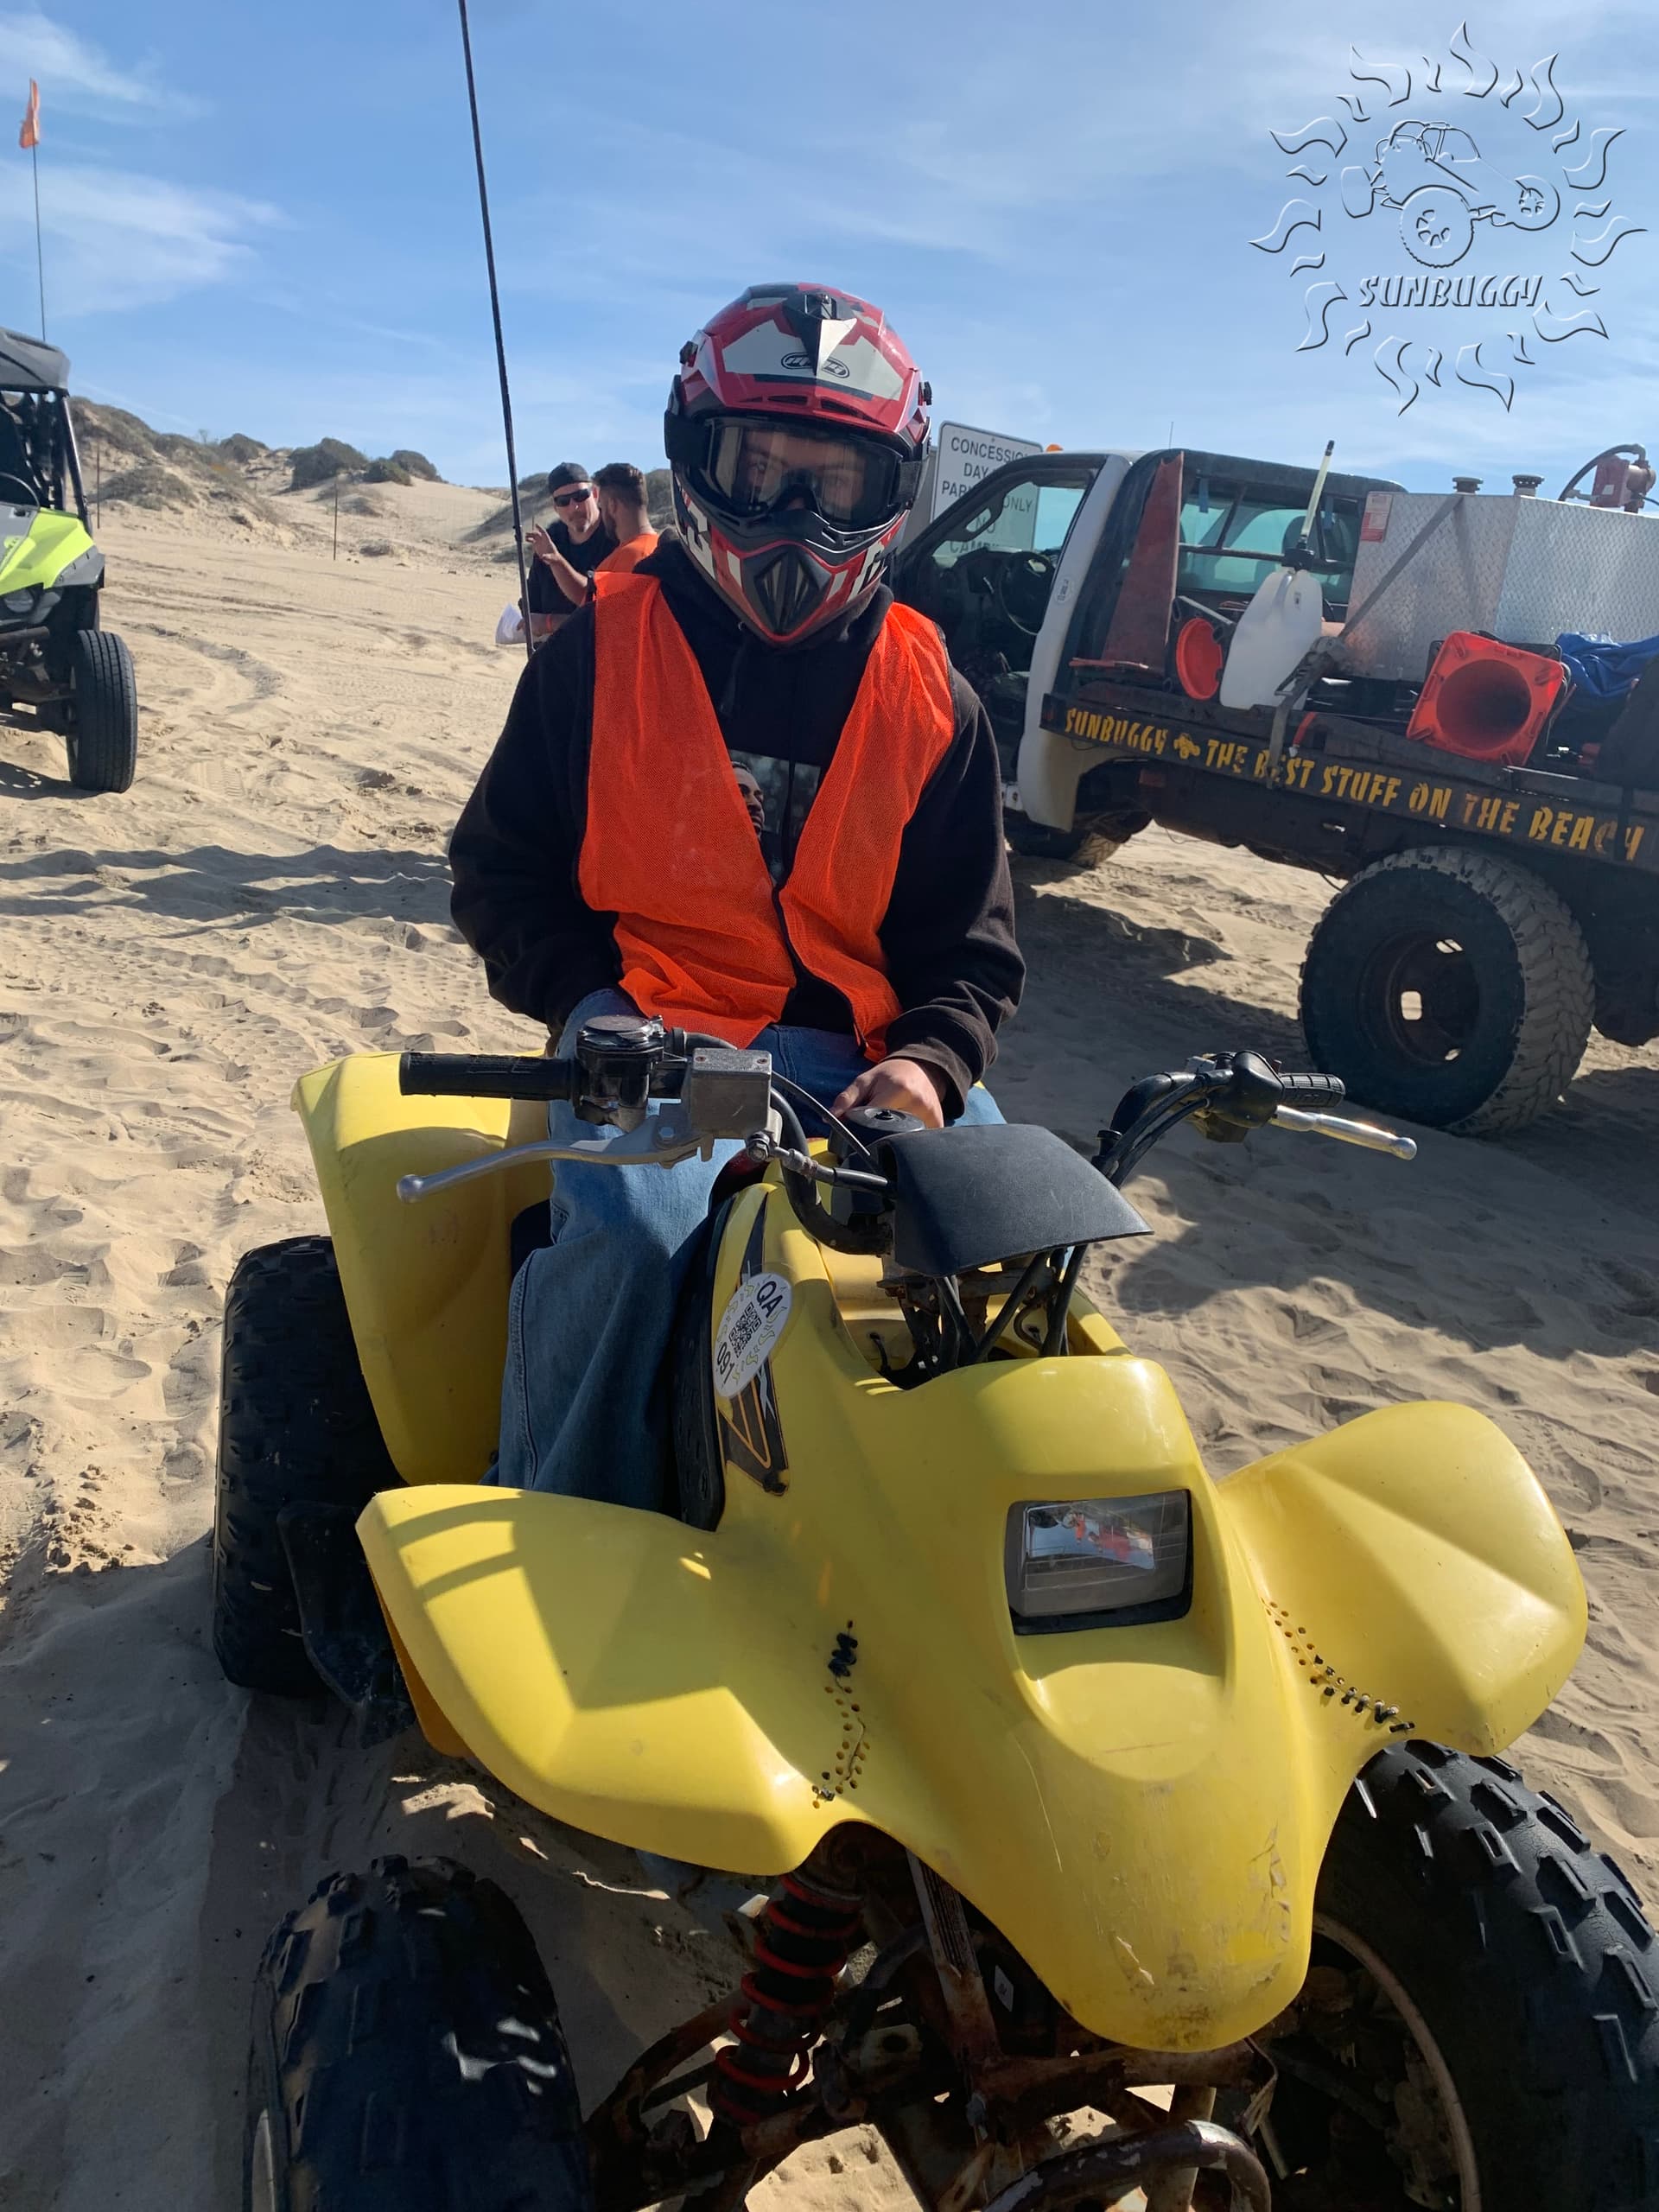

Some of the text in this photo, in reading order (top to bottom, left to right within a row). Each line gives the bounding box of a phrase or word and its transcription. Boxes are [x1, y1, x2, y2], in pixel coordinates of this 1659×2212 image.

[963, 462, 988, 479] DAY
[1003, 496, 1033, 512] ONLY
[1065, 708, 1169, 755] SUNBUGGY
[1205, 739, 1249, 774] THE
[1320, 765, 1402, 807] STUFF
[1408, 783, 1452, 819] ON
[1461, 793, 1521, 834] THE
[757, 1281, 783, 1318] QA
[717, 1342, 735, 1384] 091
